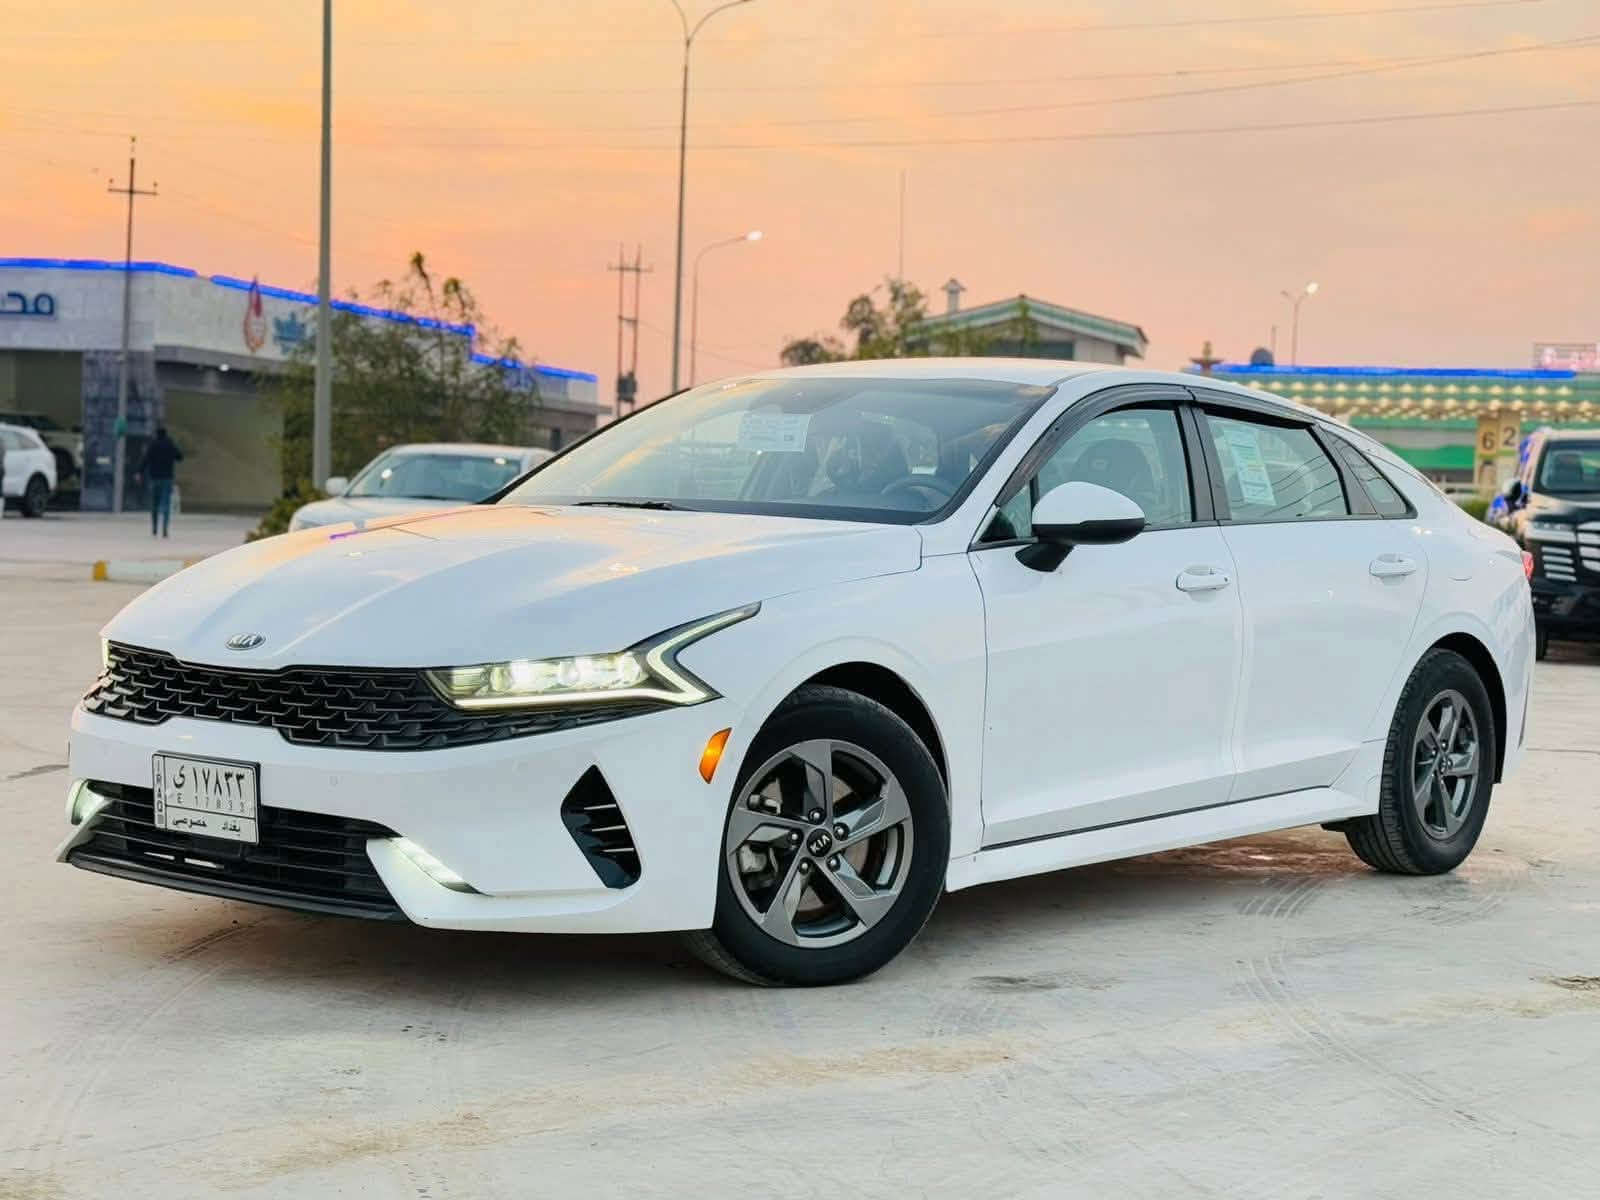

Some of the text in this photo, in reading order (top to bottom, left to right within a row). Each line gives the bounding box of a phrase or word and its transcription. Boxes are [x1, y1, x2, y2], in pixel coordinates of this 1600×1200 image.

[1482, 431, 1496, 450] 6
[1503, 426, 1517, 447] 2
[810, 834, 831, 853] KIA
